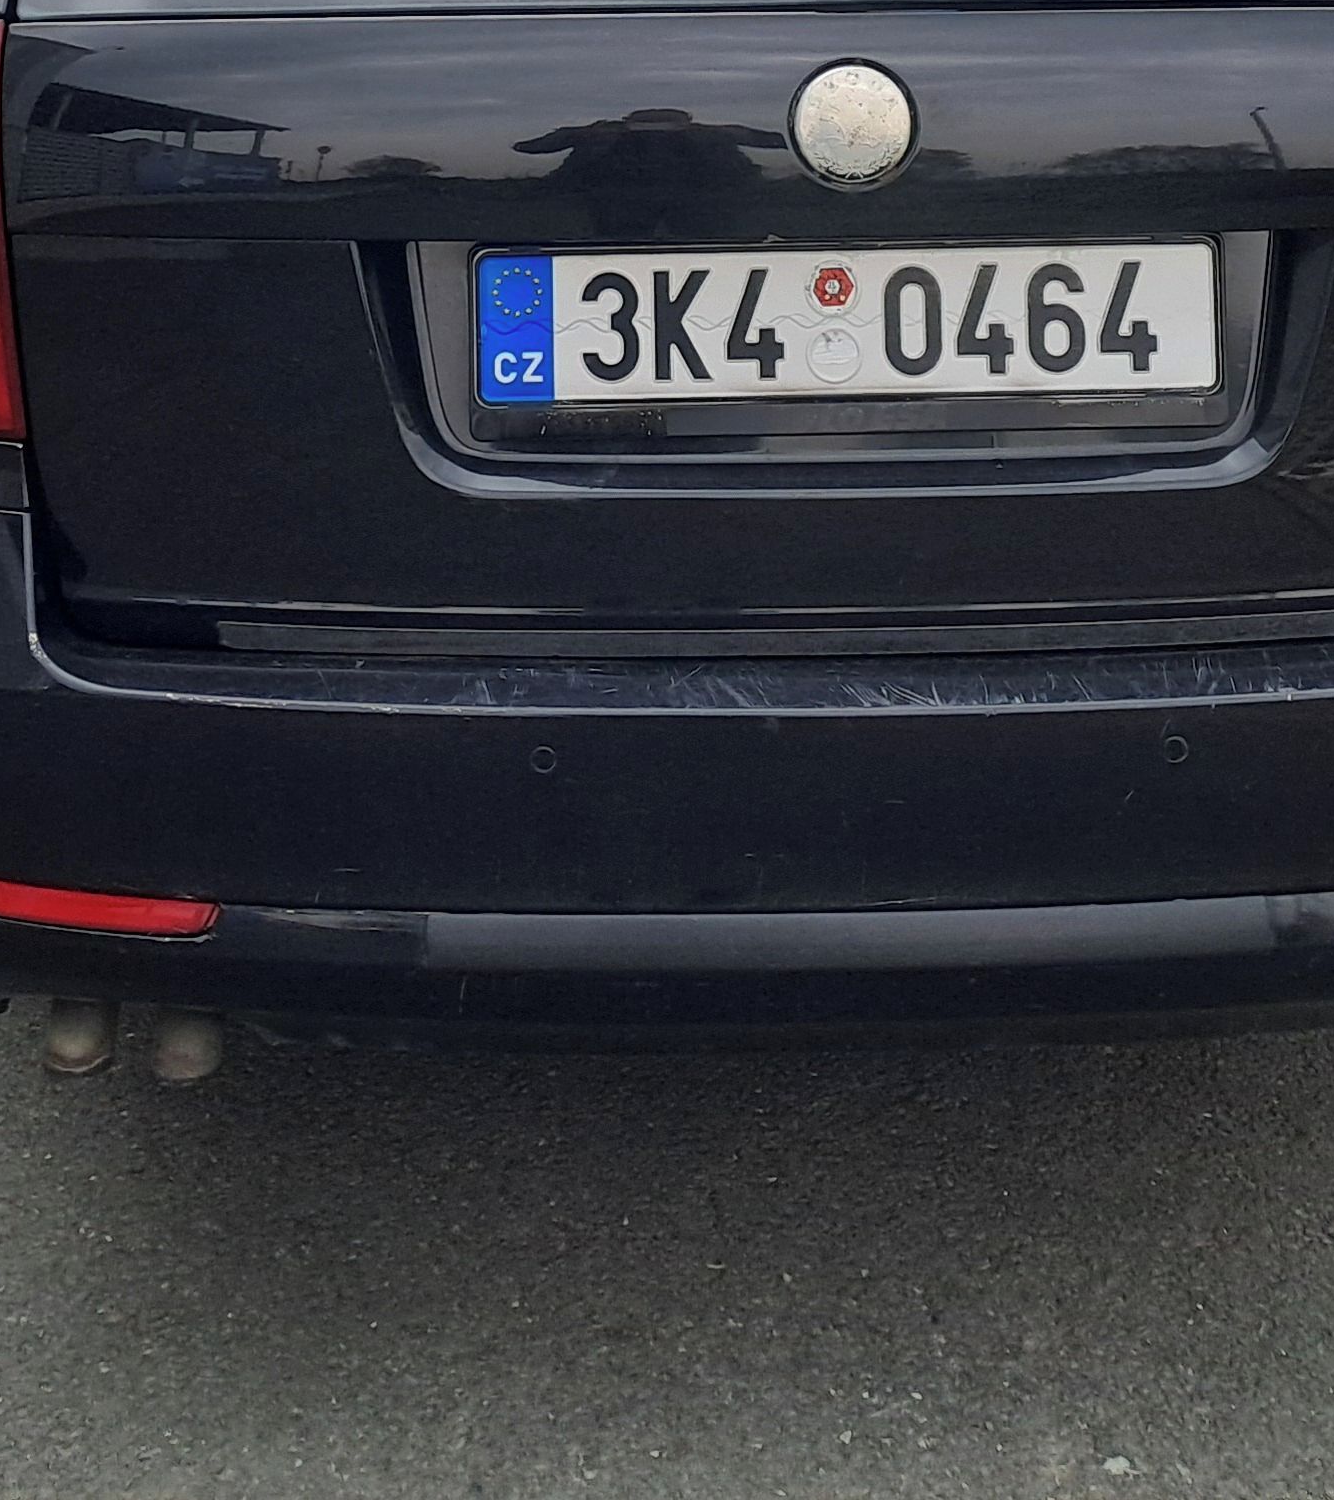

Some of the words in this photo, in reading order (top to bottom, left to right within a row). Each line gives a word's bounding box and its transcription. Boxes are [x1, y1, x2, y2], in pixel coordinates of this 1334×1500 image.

[581, 268, 785, 382] 3K4
[883, 261, 1158, 376] 0464
[493, 351, 544, 384] CZ
